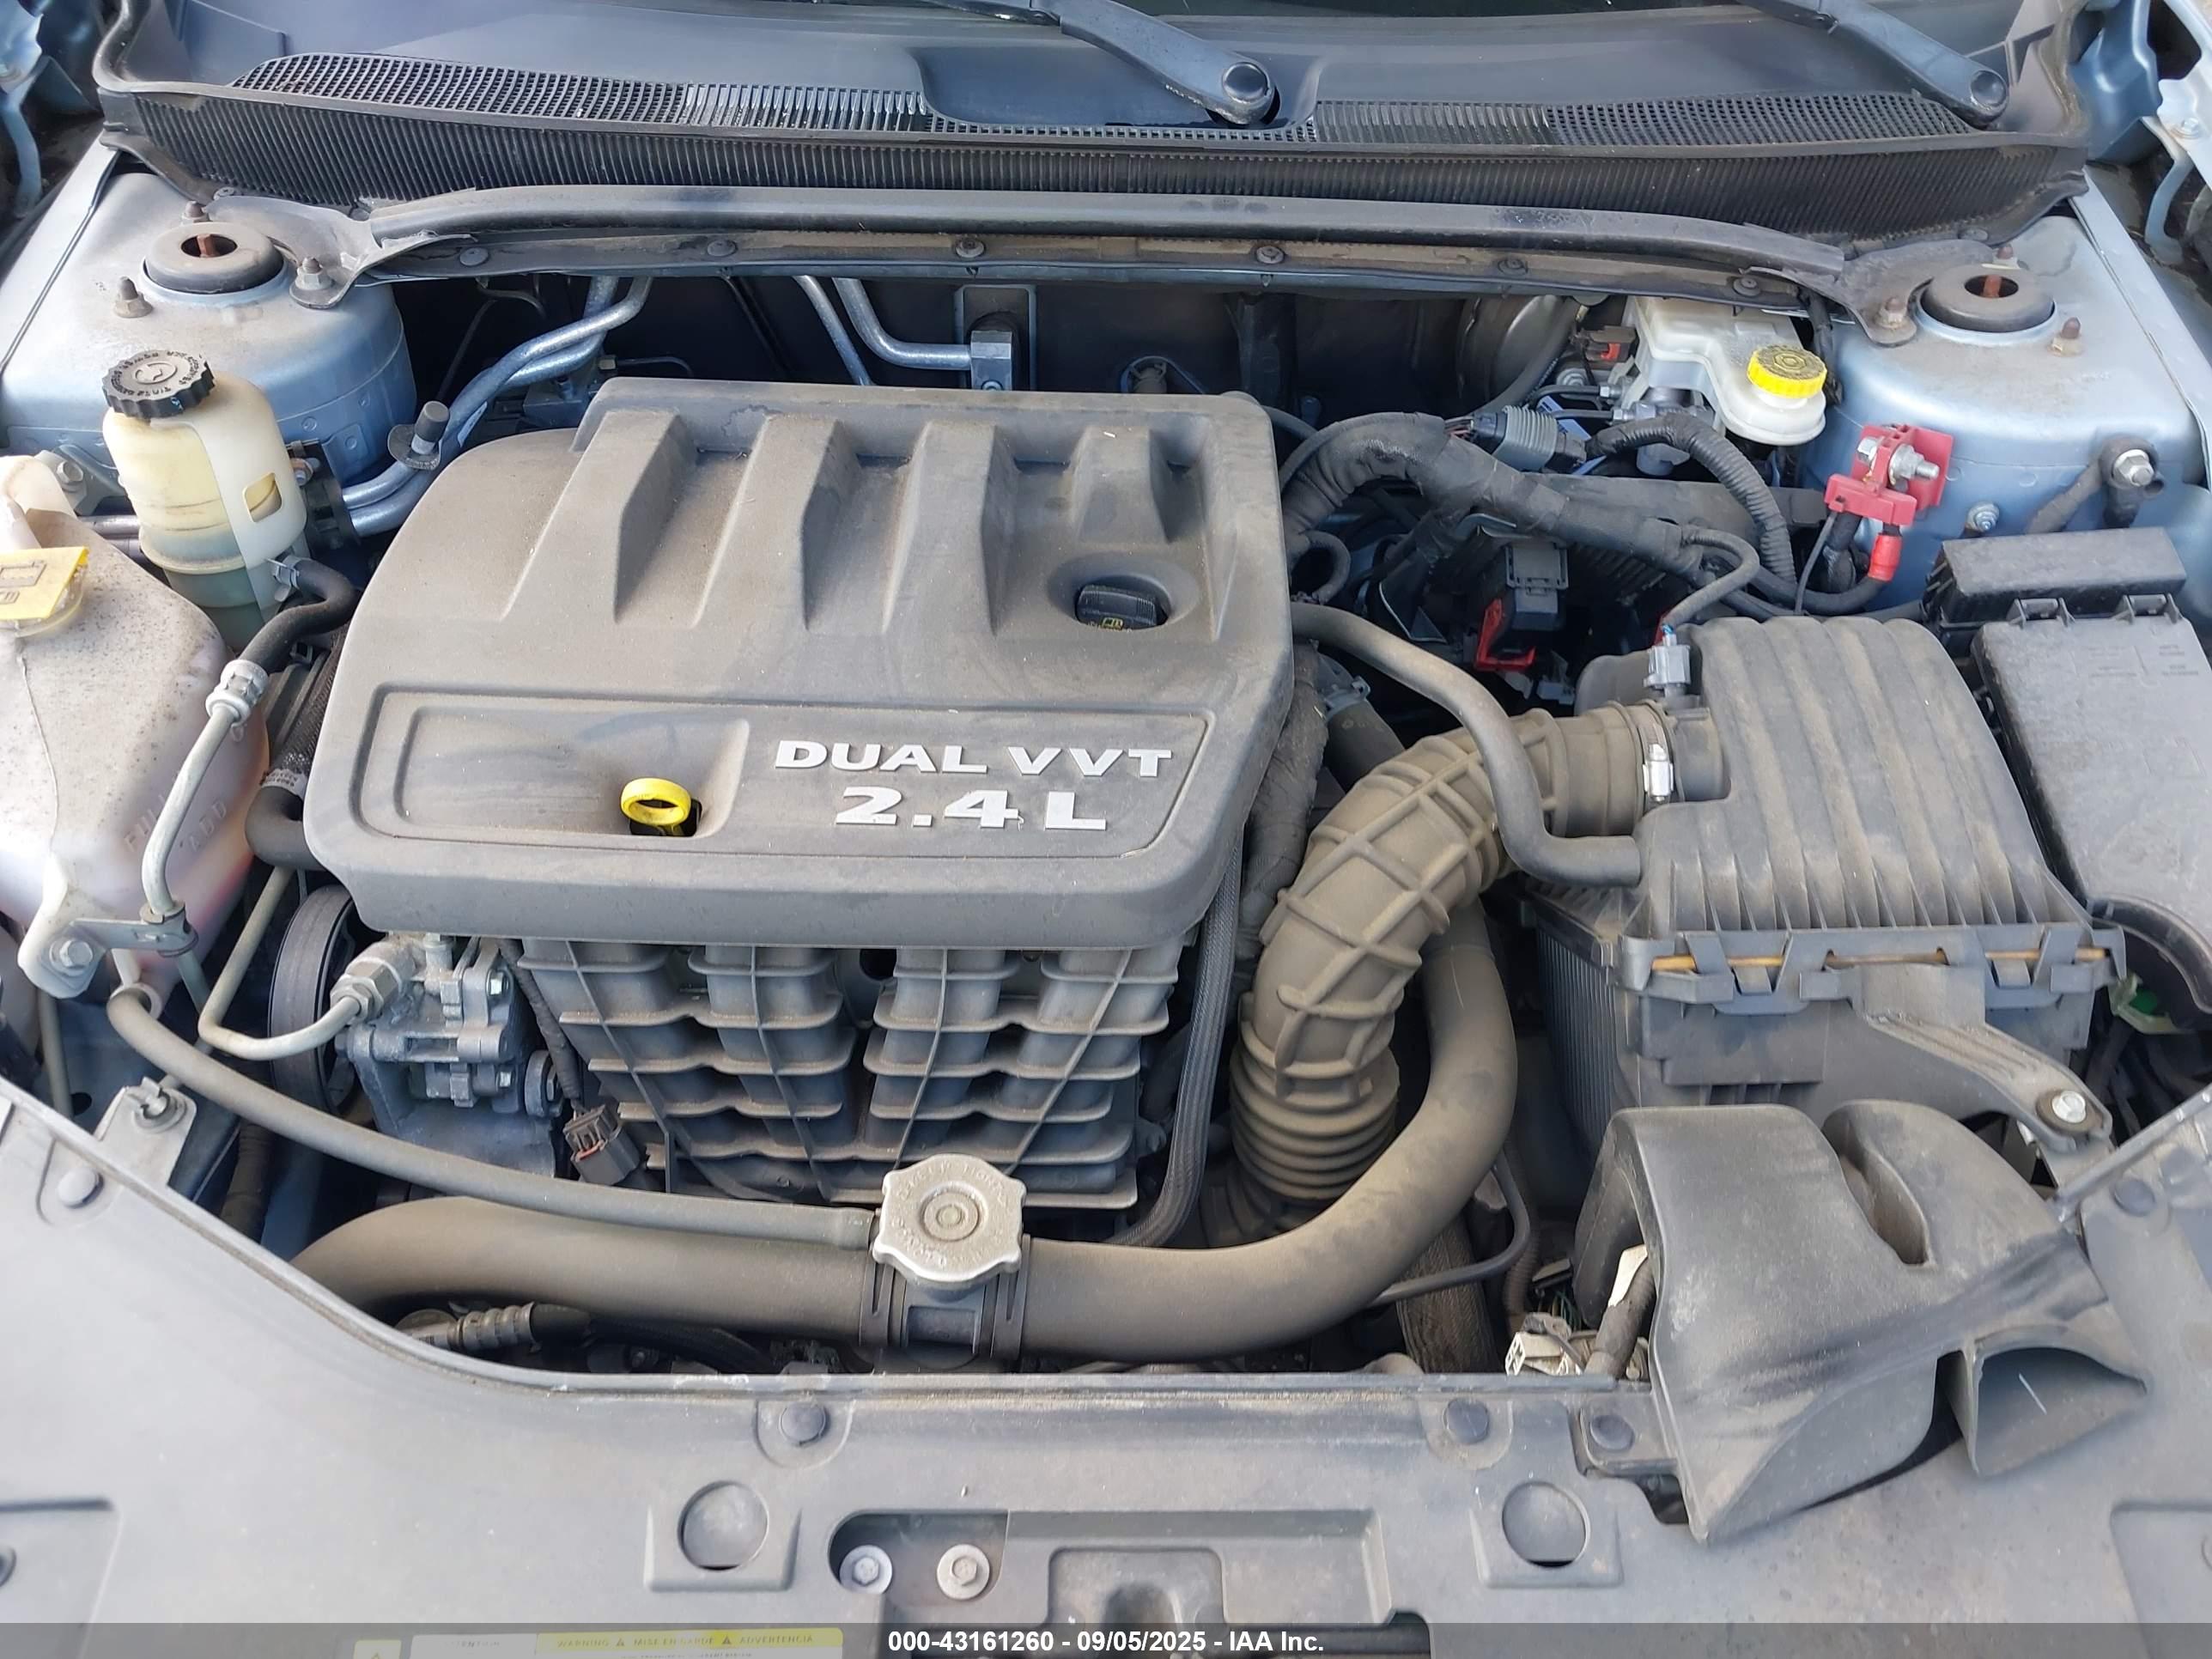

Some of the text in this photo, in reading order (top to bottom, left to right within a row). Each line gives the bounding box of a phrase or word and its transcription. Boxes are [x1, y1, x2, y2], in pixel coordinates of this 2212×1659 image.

[775, 739, 1173, 778] DUAL VVT
[557, 1638, 609, 1647] WARNING
